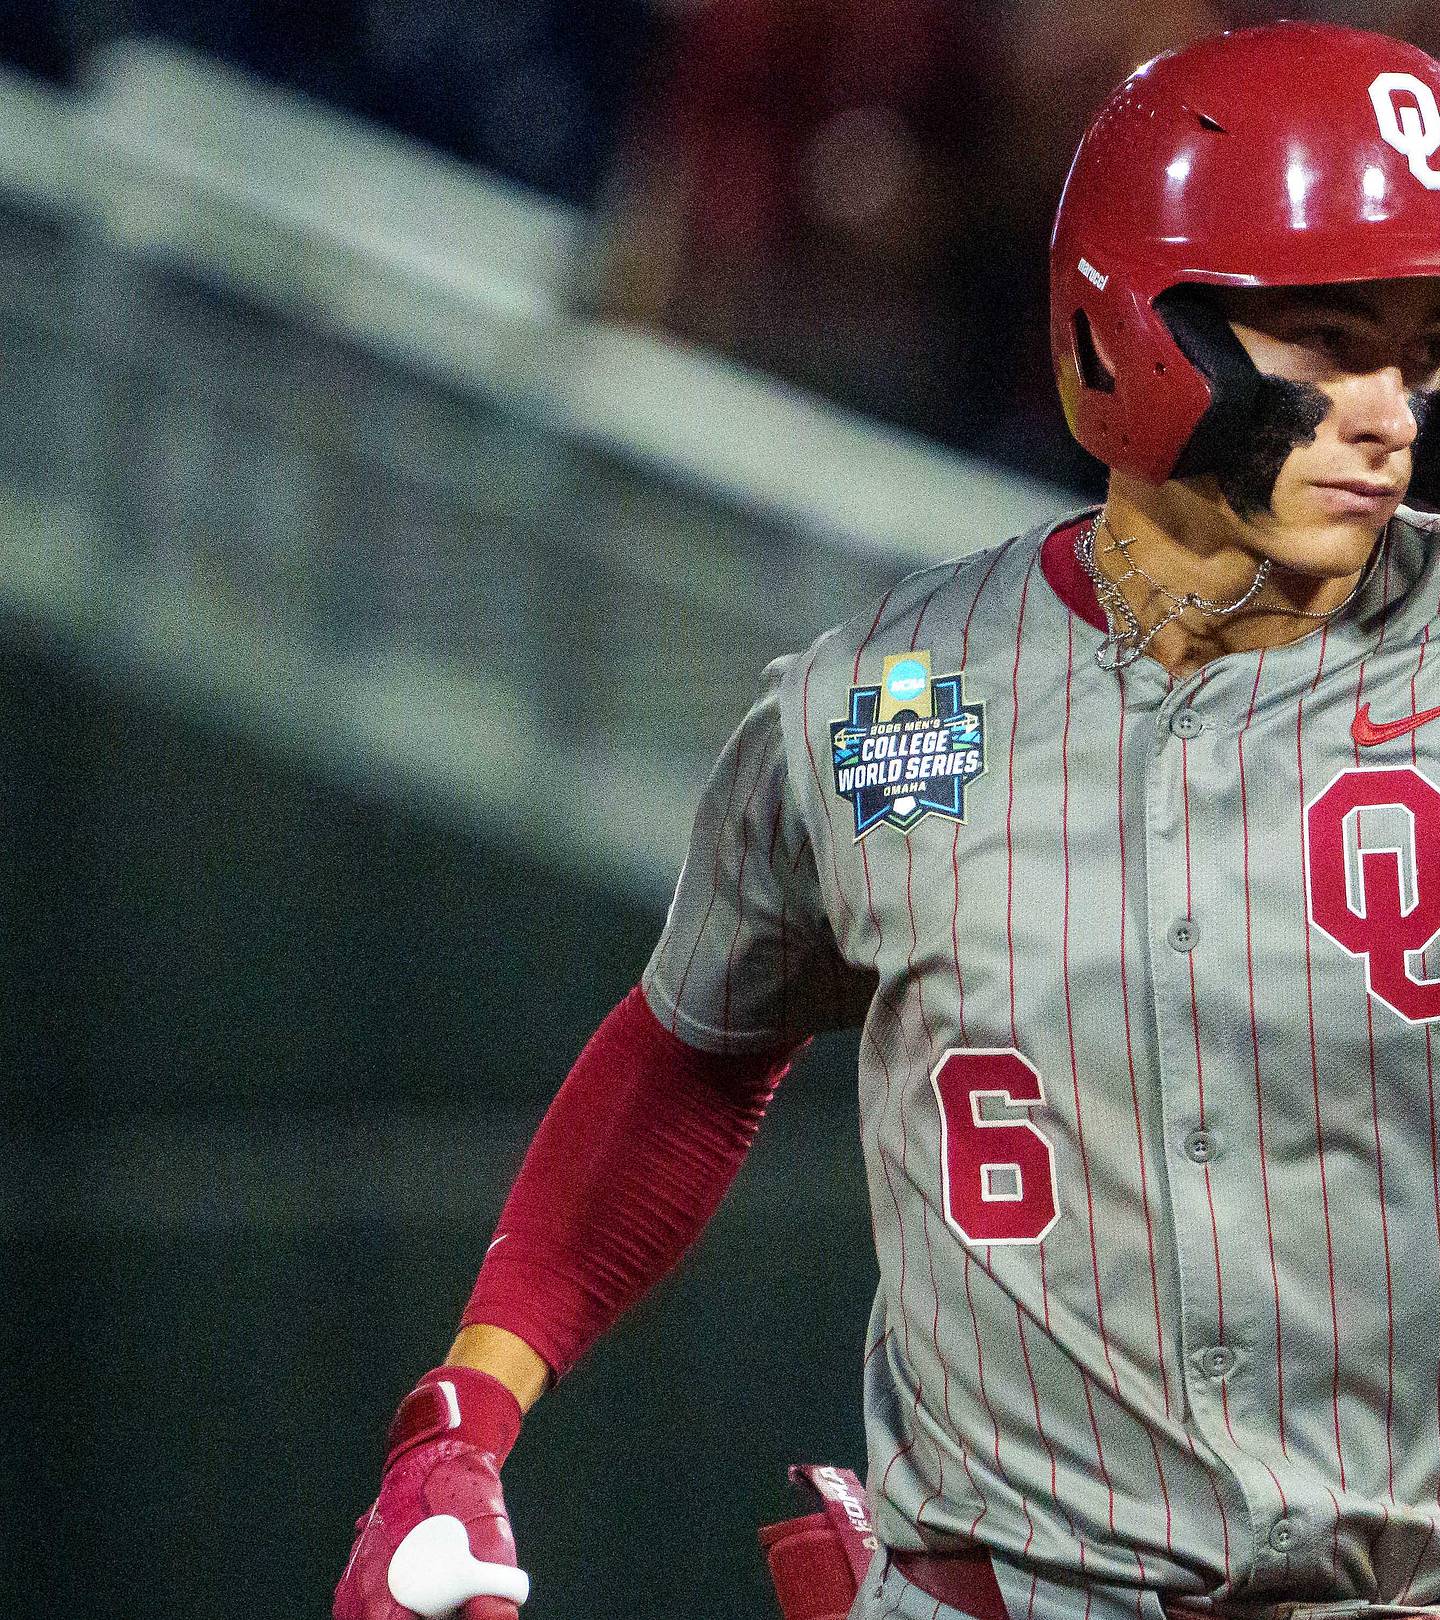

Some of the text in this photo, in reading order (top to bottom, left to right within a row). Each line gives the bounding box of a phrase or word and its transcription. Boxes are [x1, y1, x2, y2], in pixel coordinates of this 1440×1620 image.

[904, 718, 941, 732] MEN'S
[861, 731, 950, 762] COLLEGE
[838, 750, 980, 792] WORLD SERIES
[883, 781, 927, 797] OMAHA
[930, 1047, 1061, 1246] 6
